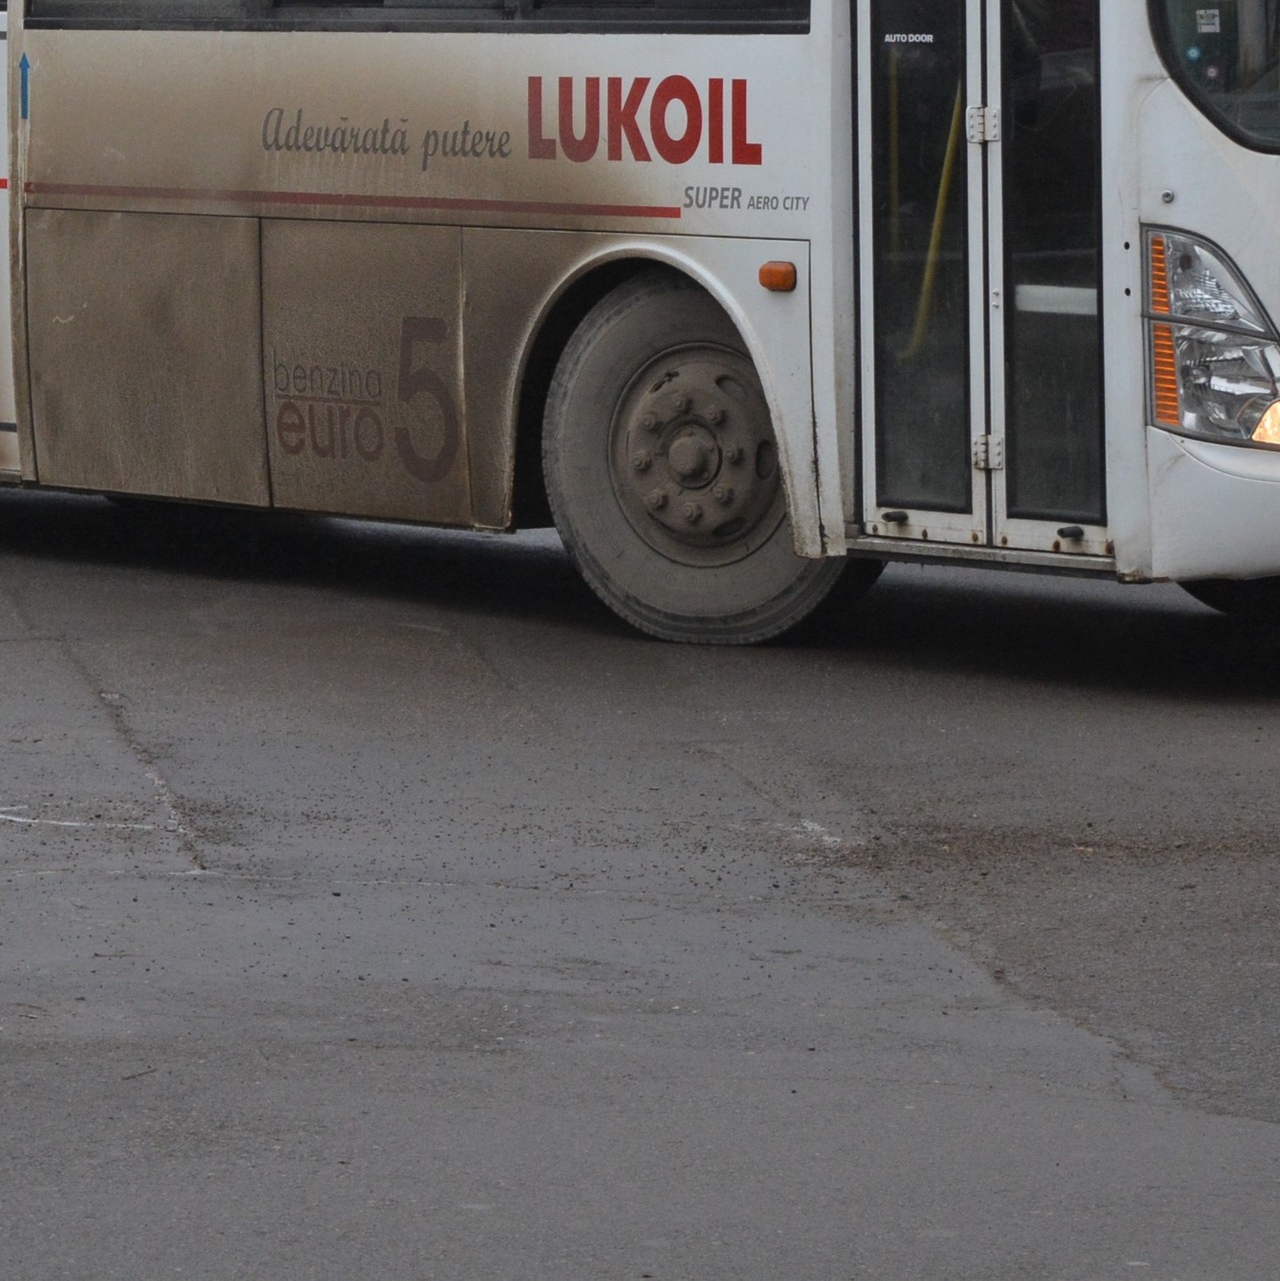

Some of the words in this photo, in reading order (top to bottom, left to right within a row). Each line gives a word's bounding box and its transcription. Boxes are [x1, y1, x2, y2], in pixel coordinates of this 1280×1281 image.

[884, 33, 907, 43] AUTO
[908, 33, 934, 43] DOOR
[261, 107, 410, 156] Adevărată
[422, 120, 513, 172] putere
[528, 74, 763, 166] LUKOIL
[683, 186, 742, 209] SUPER
[747, 195, 779, 211] AERO
[782, 196, 810, 211] CITY
[273, 345, 382, 399] benzina
[394, 316, 459, 483] 5
[276, 401, 384, 462] euro
